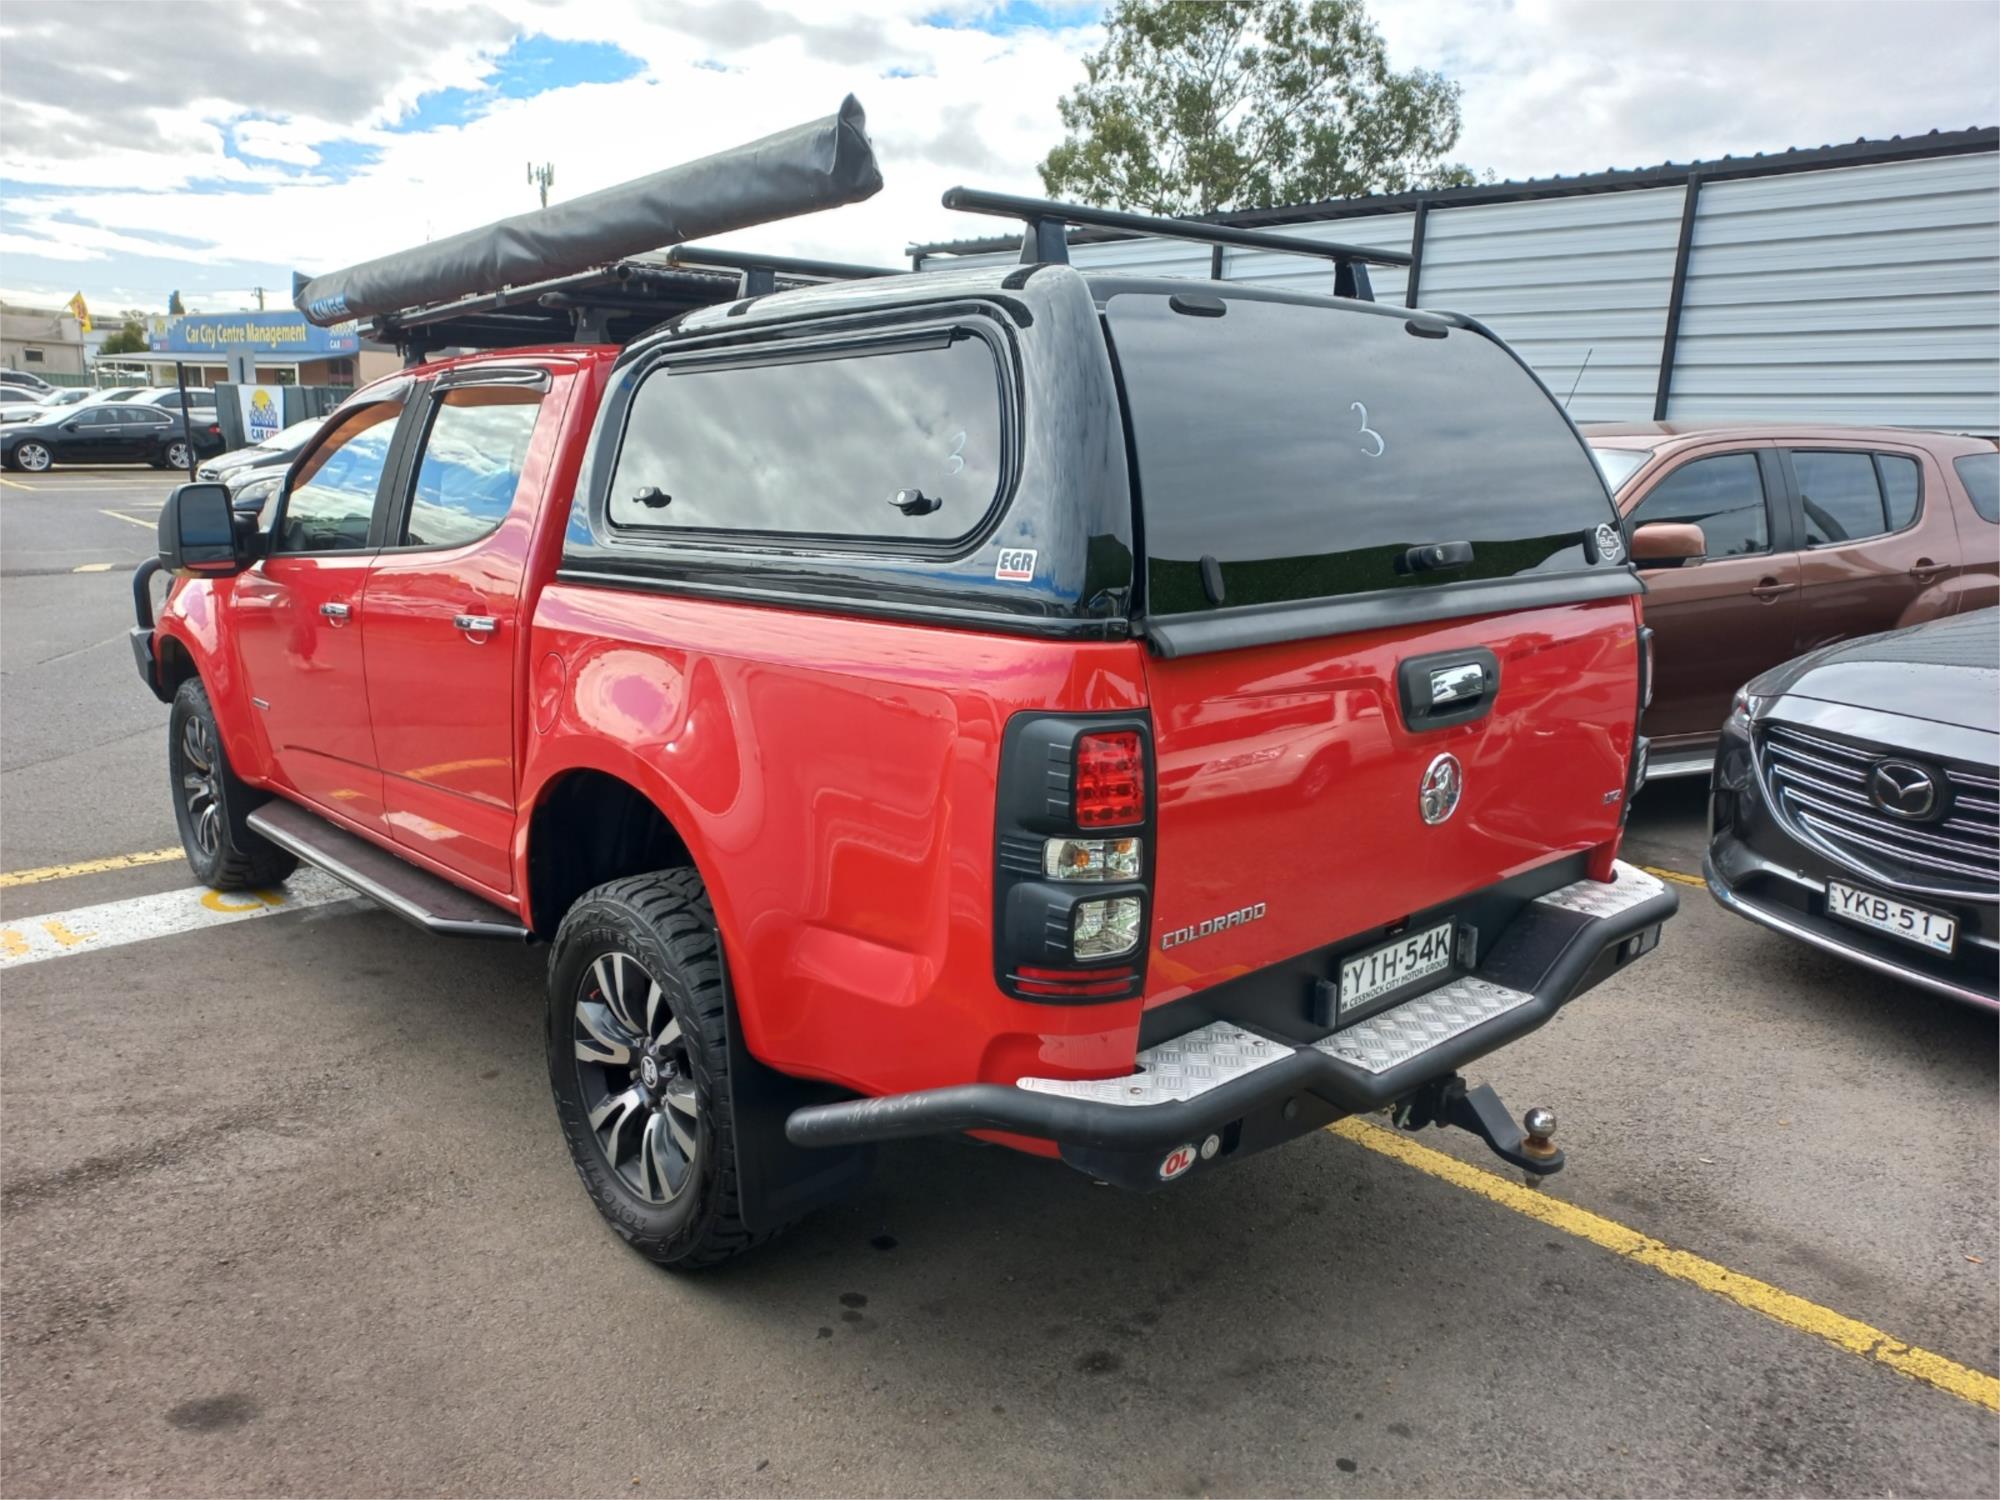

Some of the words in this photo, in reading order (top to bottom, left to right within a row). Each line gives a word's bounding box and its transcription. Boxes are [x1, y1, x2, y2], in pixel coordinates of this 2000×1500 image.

[308, 297, 351, 320] KINGS
[186, 325, 199, 343] Car
[200, 324, 216, 349] City
[216, 322, 245, 343] Centre
[245, 322, 306, 349] Management
[250, 428, 265, 440] CAR
[1350, 401, 1385, 457] 3
[947, 430, 967, 475] 3
[1000, 551, 1034, 572] EGR
[1161, 902, 1266, 950] COLORADO
[1350, 985, 1384, 1007] CESSNOCK
[1385, 977, 1401, 991] CITY
[1401, 966, 1424, 983] MOTOR
[1425, 958, 1448, 972] GROUP
